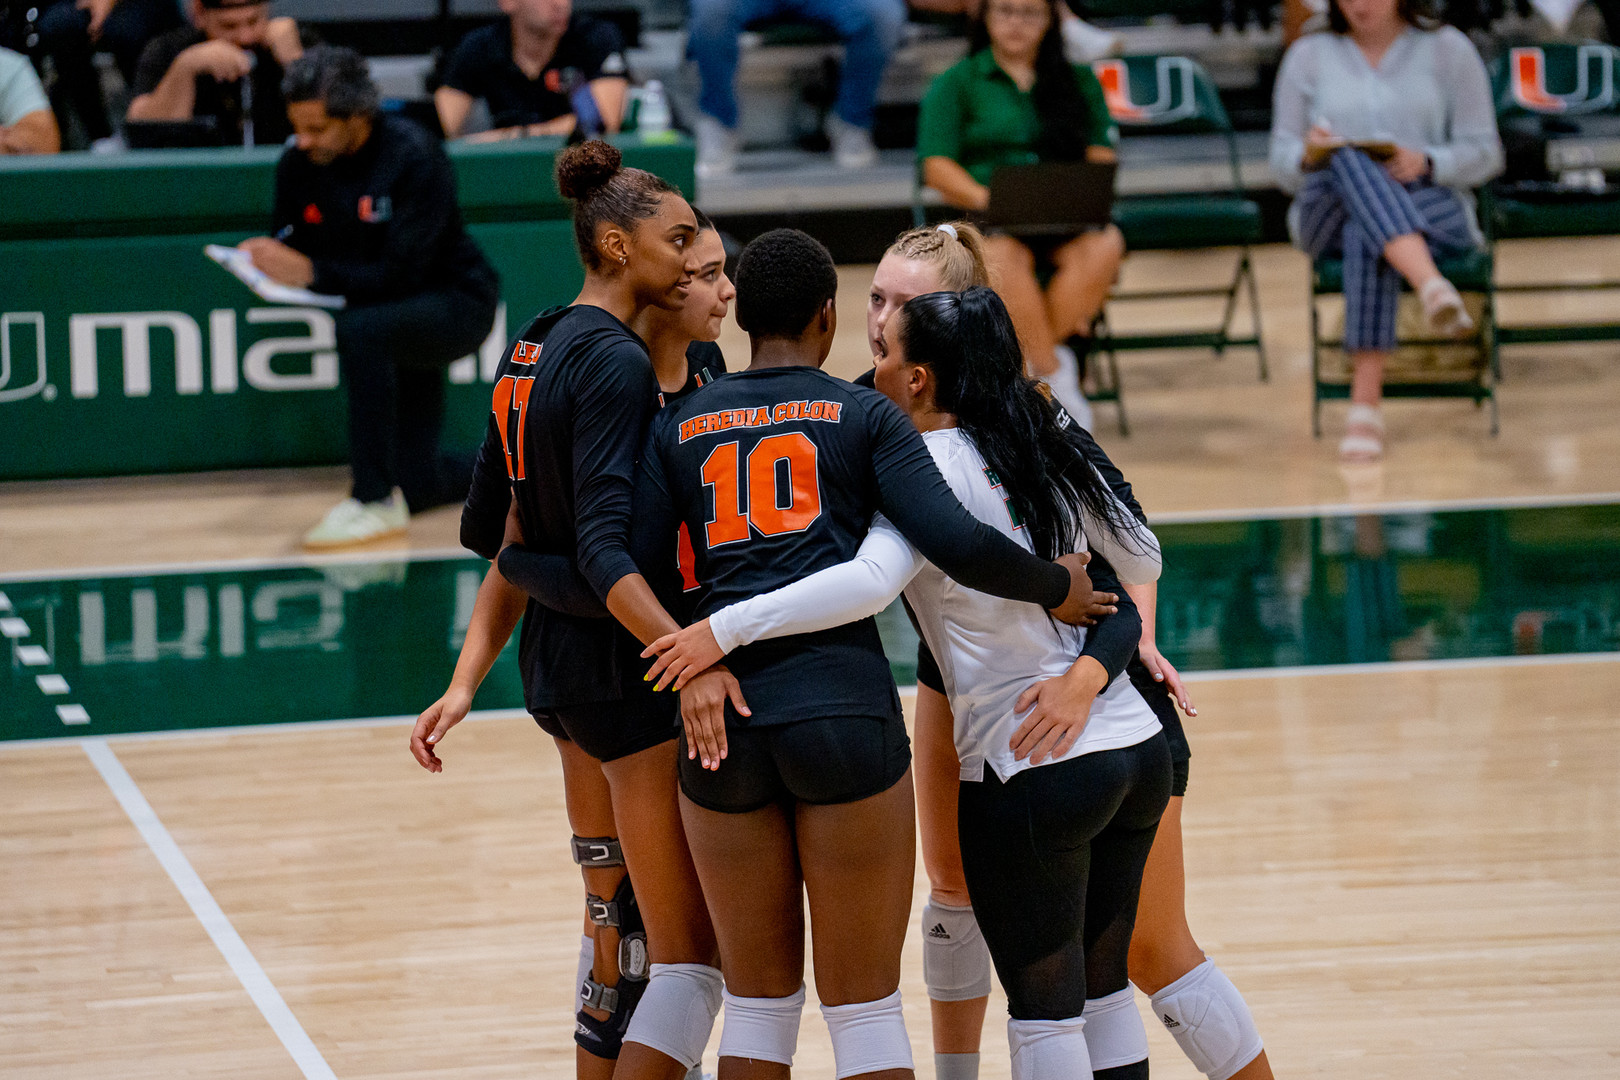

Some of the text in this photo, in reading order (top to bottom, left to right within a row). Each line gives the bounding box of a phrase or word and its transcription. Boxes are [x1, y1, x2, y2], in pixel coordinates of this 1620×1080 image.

[678, 400, 842, 444] HEREDIA COLON
[700, 431, 822, 550] 10
